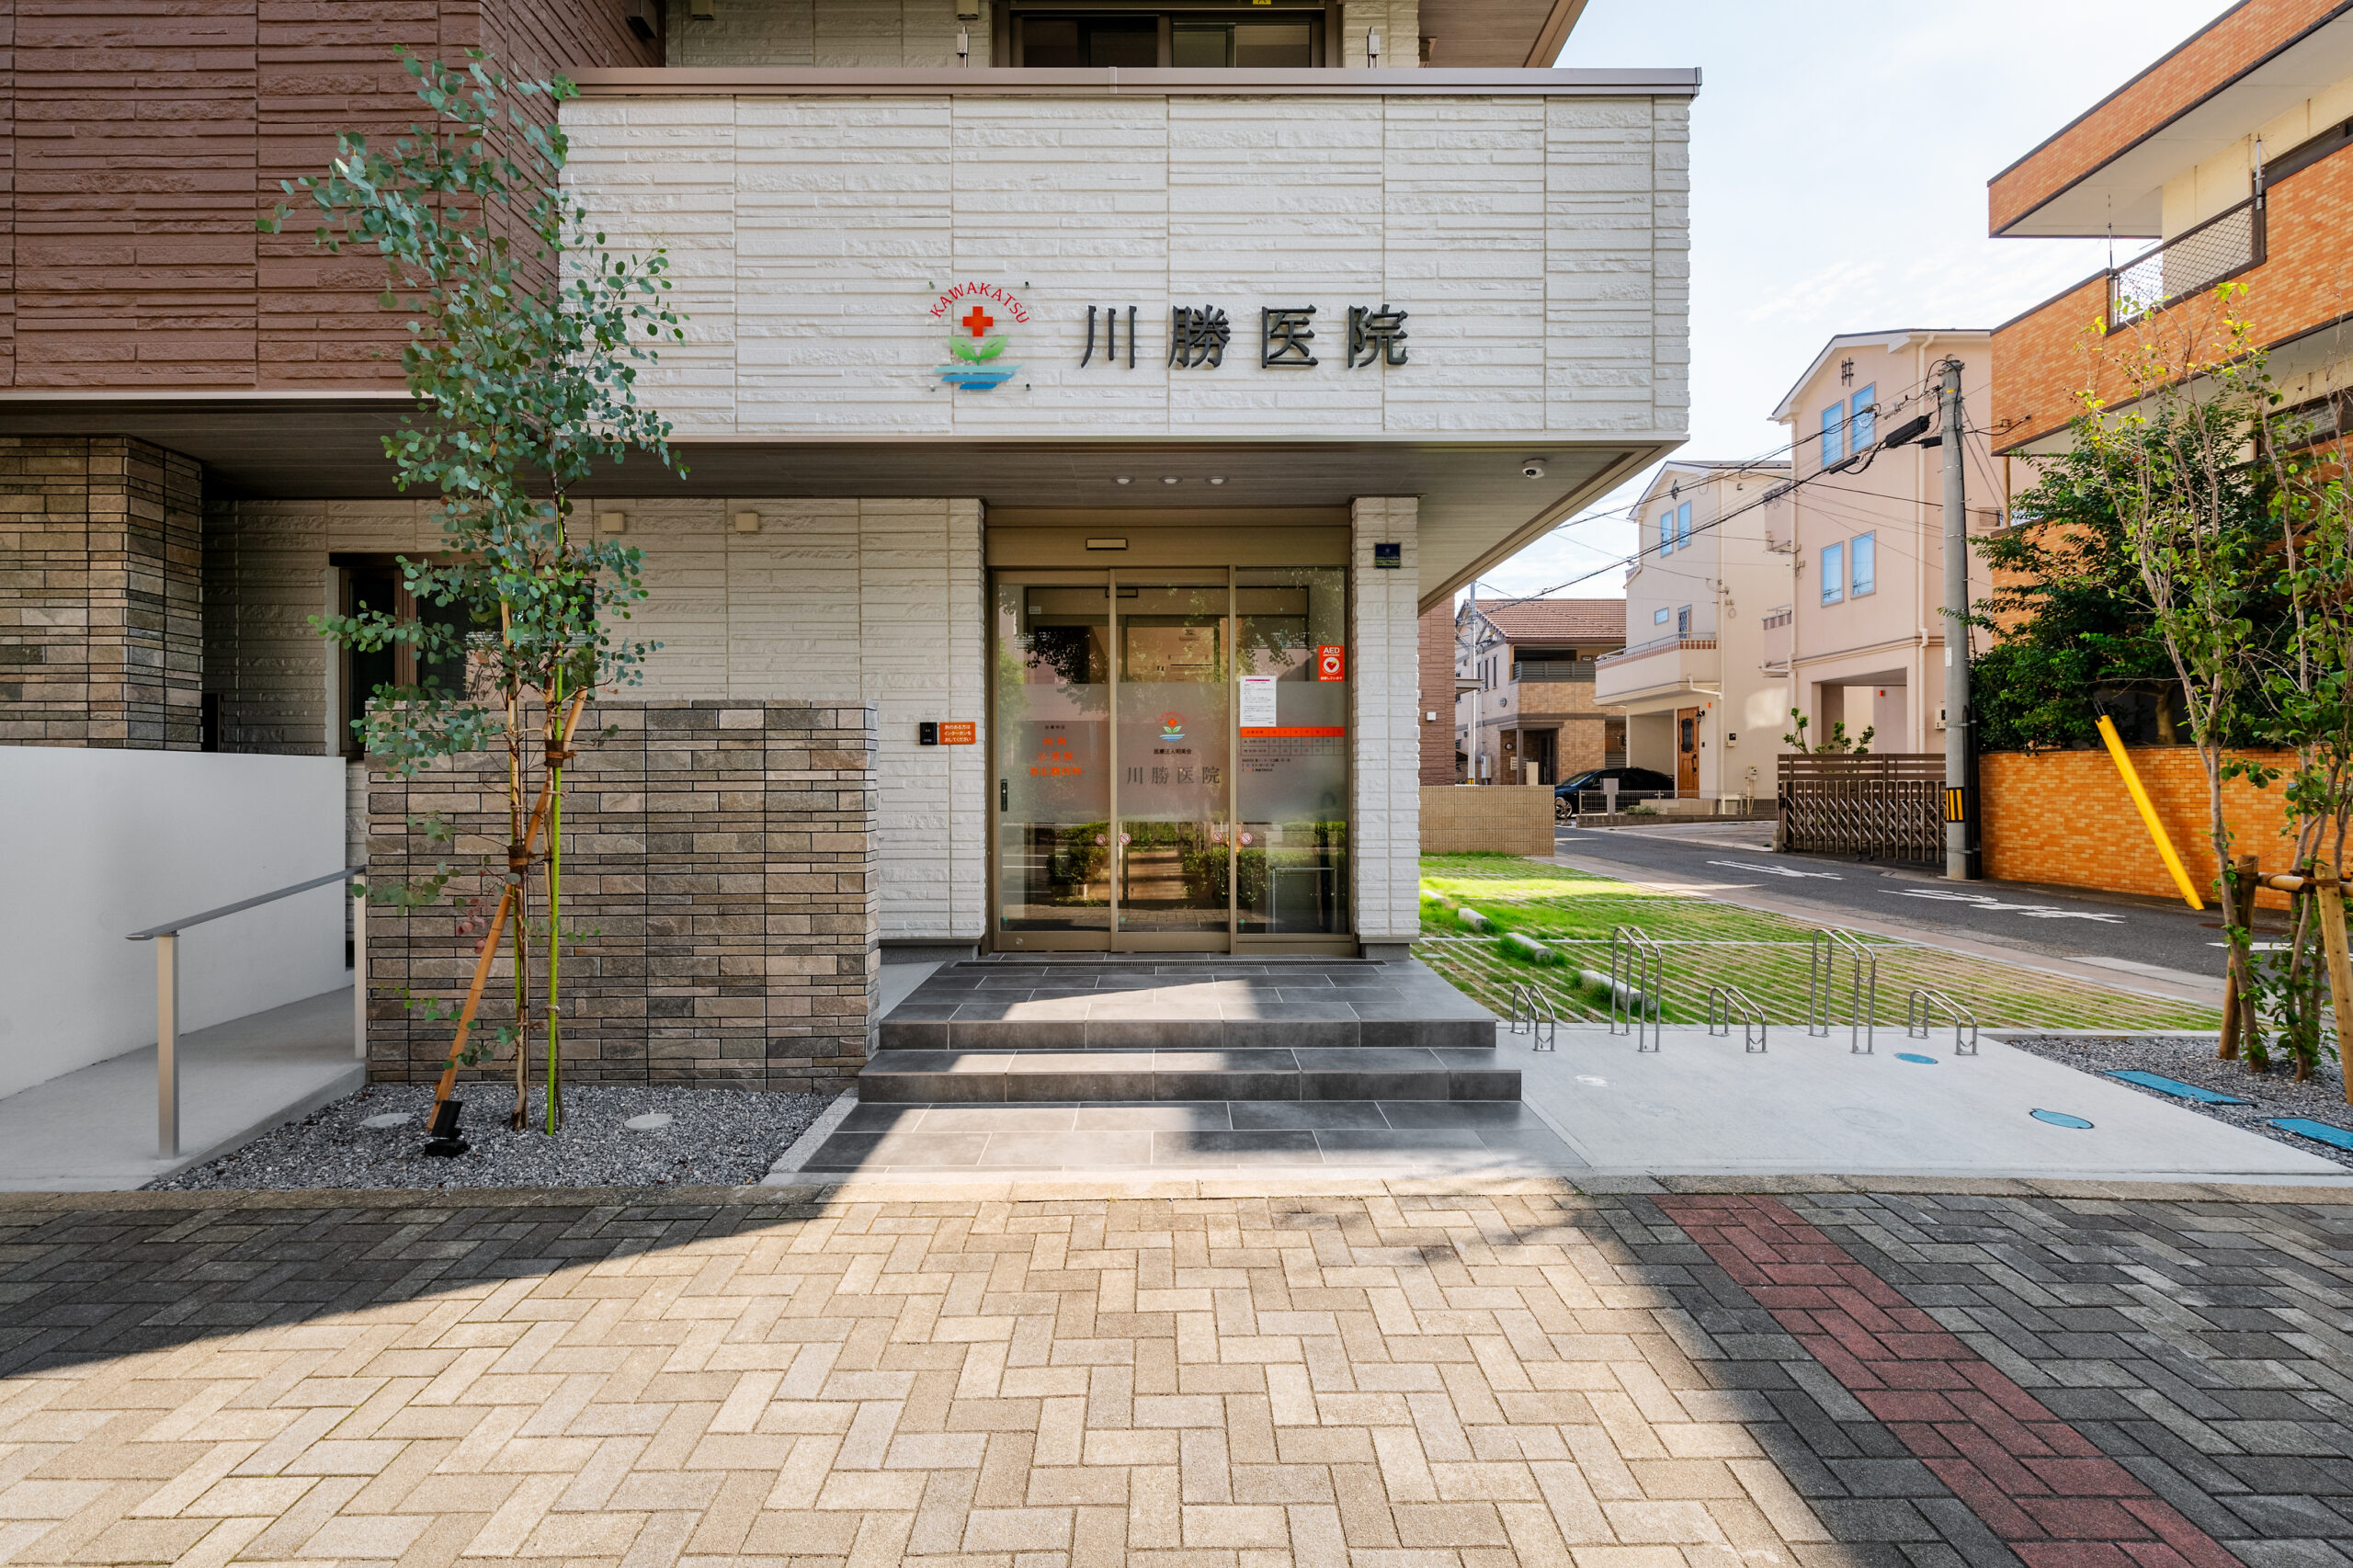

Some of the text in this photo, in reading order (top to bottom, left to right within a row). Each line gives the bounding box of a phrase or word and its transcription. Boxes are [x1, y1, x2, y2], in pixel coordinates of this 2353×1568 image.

[930, 281, 1029, 324] KAWAKATSU
[1081, 303, 1409, 369] 川勝医院
[1127, 766, 1221, 785] 川勝医院
